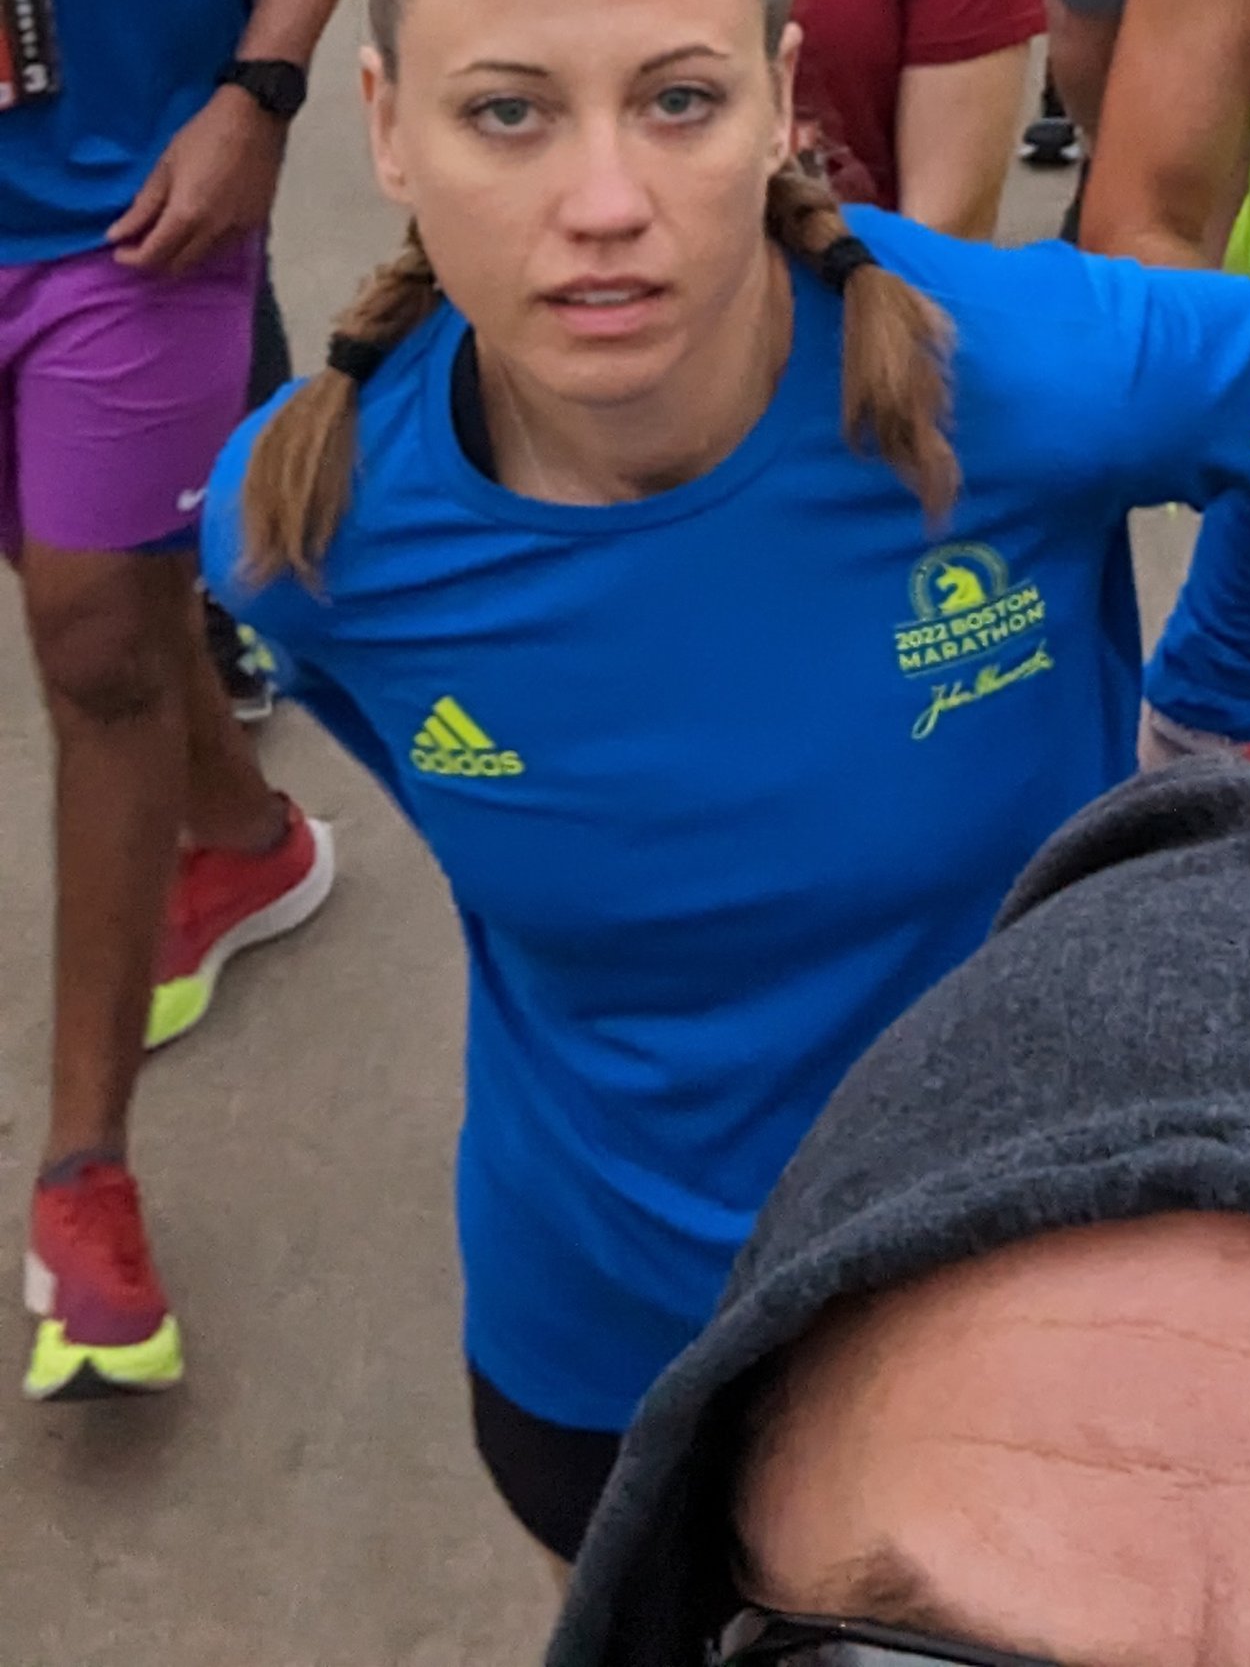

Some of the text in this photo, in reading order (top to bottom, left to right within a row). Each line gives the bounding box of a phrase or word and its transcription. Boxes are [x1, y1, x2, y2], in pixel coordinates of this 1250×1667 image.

[895, 584, 1039, 651] 2022 BOSTON
[899, 600, 1046, 671] MARATHON
[409, 748, 525, 777] adidas
